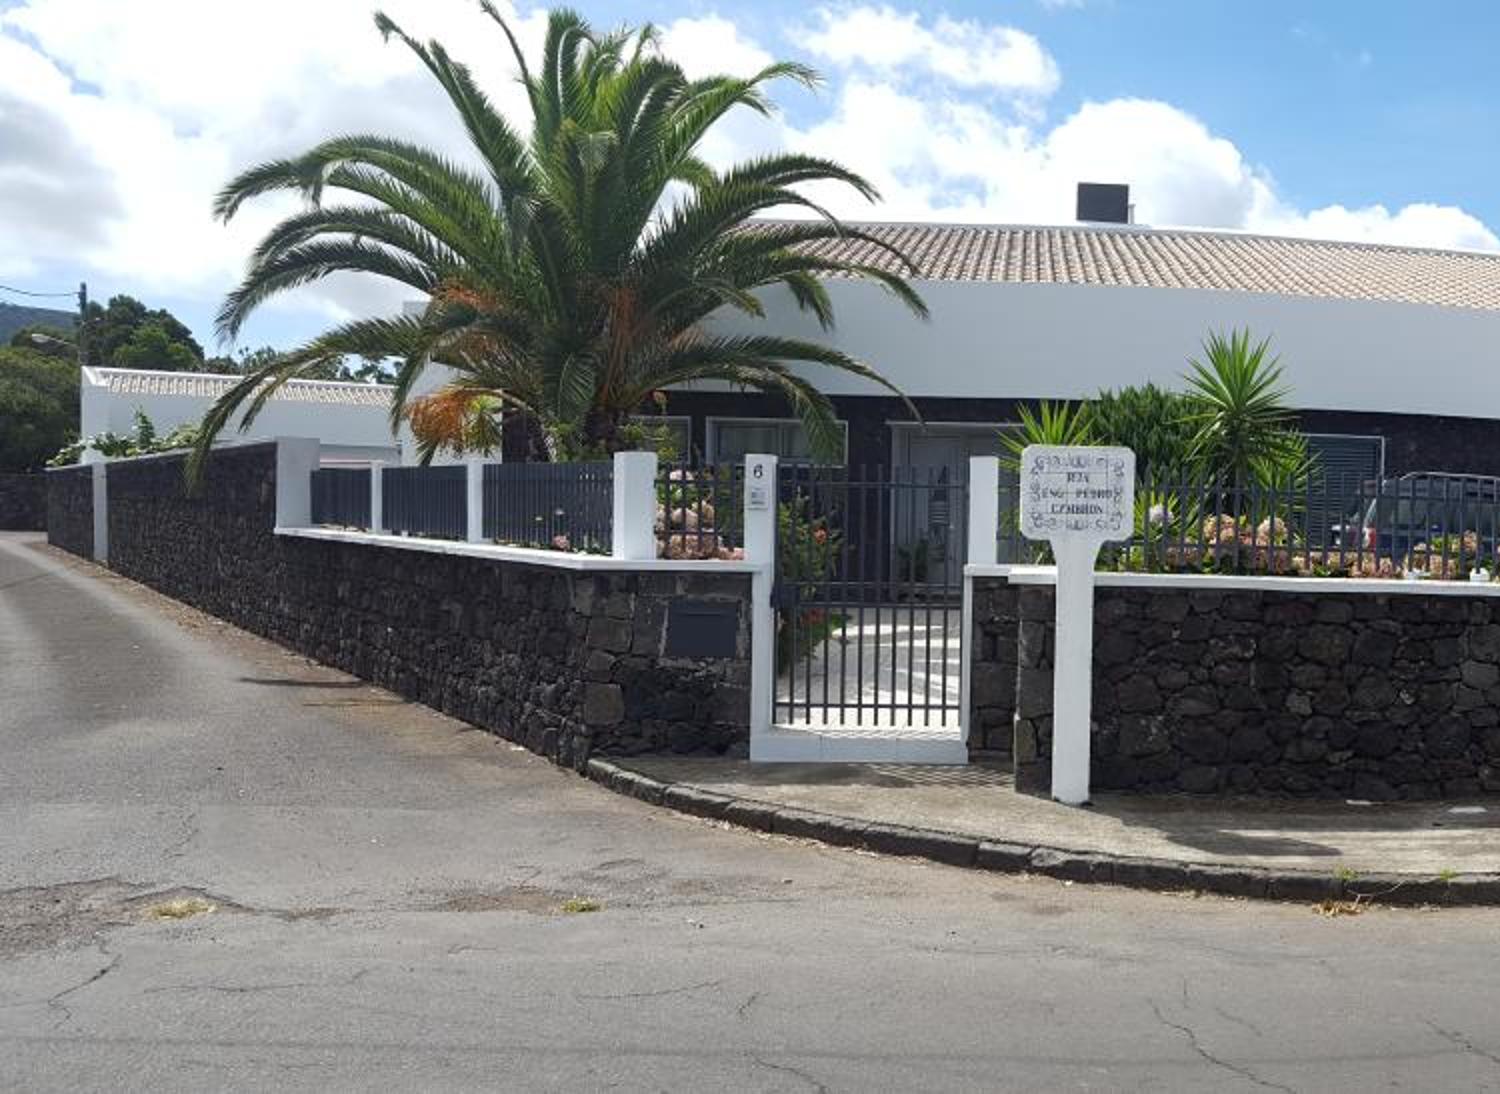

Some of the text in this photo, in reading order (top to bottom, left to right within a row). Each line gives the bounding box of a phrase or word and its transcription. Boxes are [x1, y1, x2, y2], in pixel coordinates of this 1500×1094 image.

[753, 464, 763, 479] 6
[1067, 472, 1089, 483] RUA
[1076, 488, 1113, 499] PEDRO
